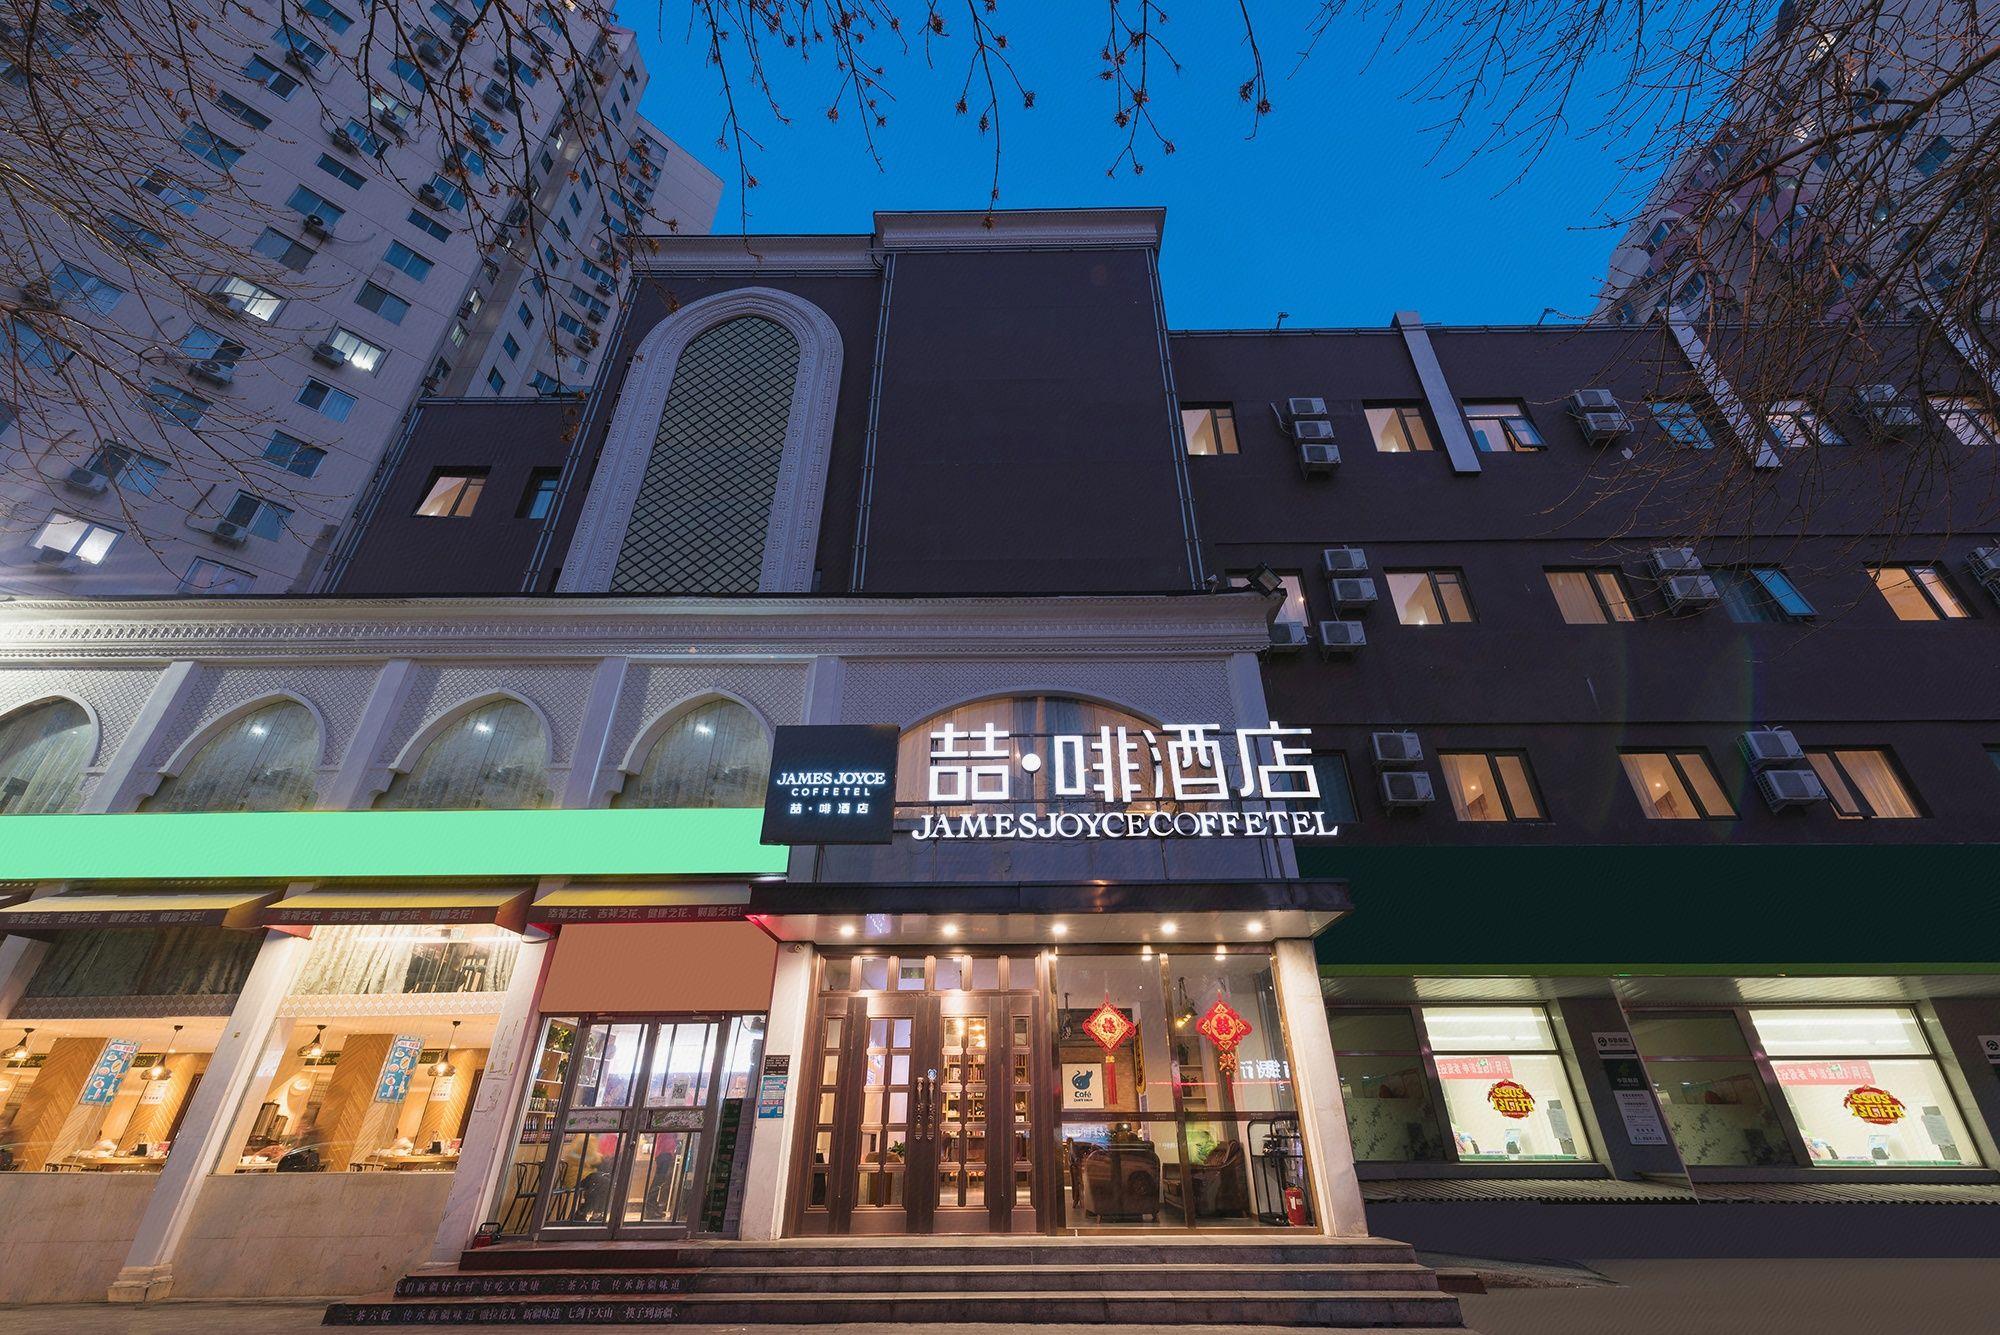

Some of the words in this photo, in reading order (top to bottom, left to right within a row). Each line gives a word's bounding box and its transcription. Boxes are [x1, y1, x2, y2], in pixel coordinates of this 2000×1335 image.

[777, 772, 832, 785] JAMES
[833, 772, 886, 785] JOYCE
[791, 787, 871, 797] COFFETEL
[912, 811, 1338, 841] JAMESJOYCECOFFETEL
